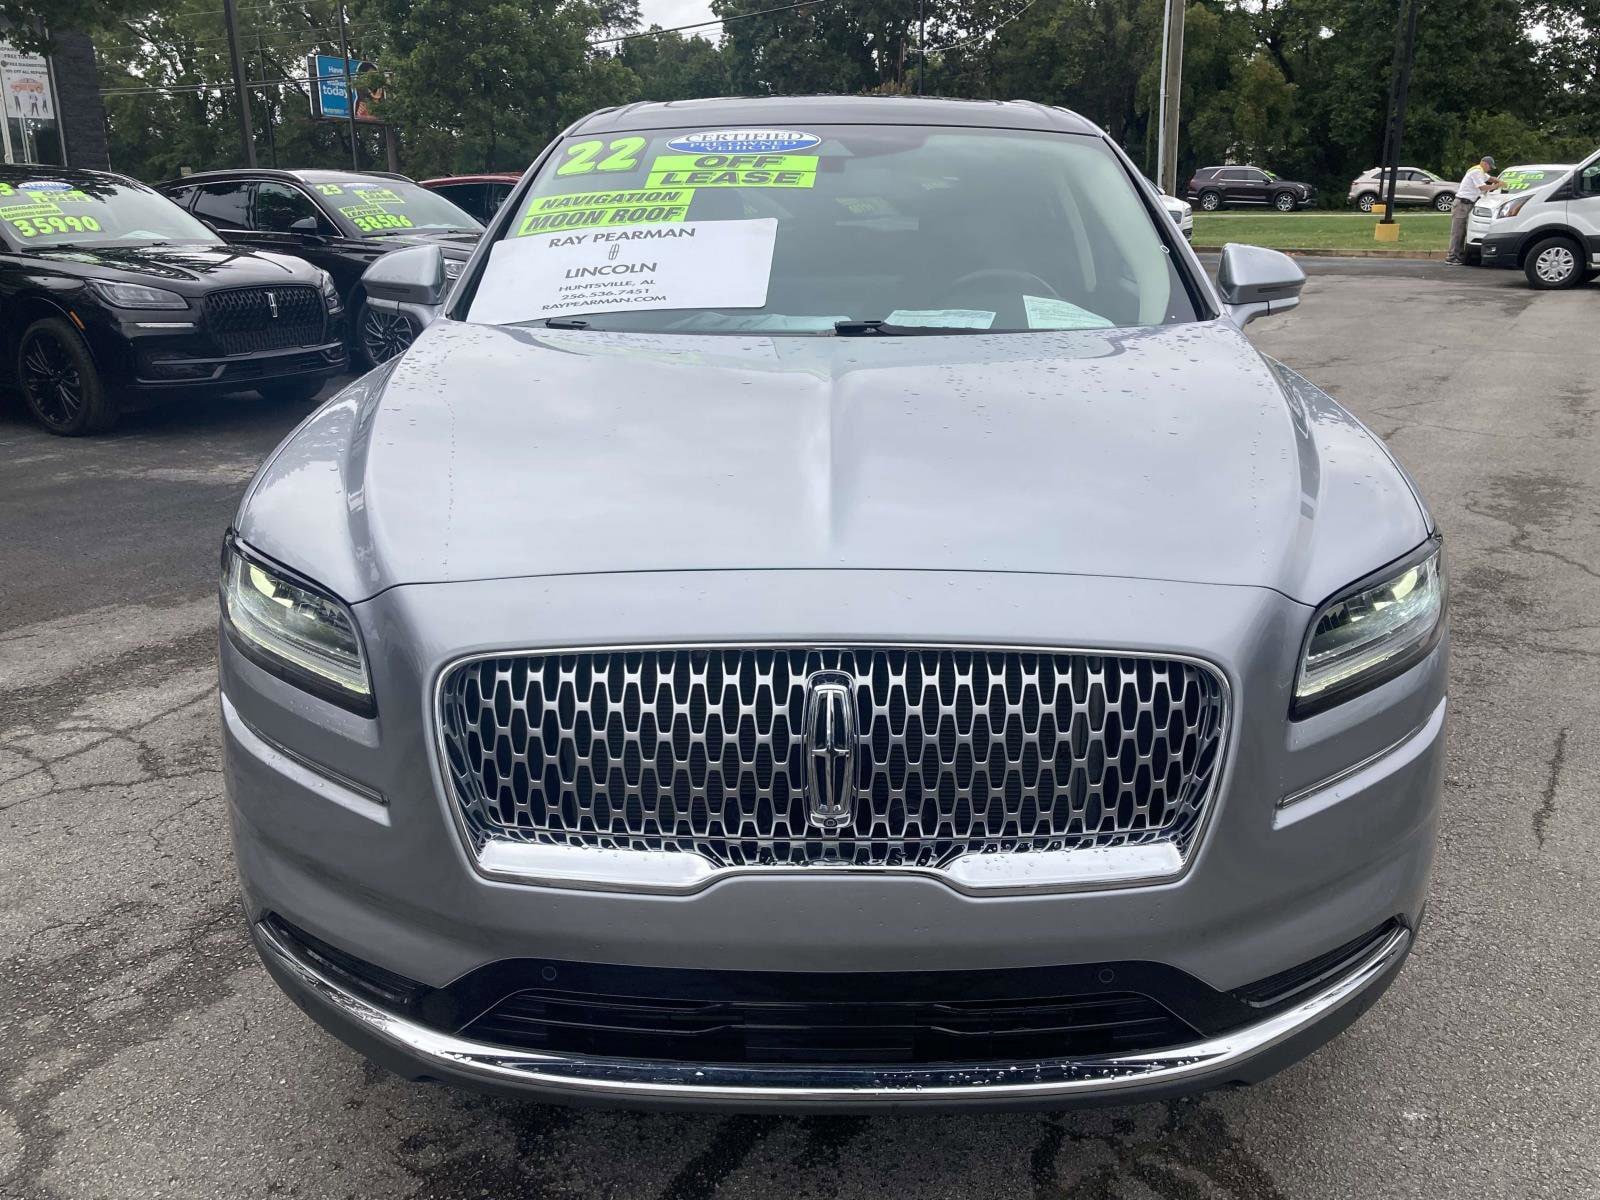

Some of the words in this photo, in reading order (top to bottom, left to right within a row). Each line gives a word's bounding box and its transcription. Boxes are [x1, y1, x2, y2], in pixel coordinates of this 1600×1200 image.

[323, 84, 348, 98] today
[685, 132, 804, 142] CERTIFIED
[557, 137, 646, 176] 22
[694, 155, 786, 169] OFF
[660, 171, 804, 186] LEASE
[539, 191, 683, 210] NAVIGATION
[12, 215, 102, 238] 35990
[353, 214, 413, 232] 38586
[525, 210, 606, 232] MOON
[608, 207, 686, 224] ROOF
[549, 234, 588, 248] RAY
[592, 228, 696, 243] PEARMAN
[565, 262, 658, 279] LINCOLN
[558, 281, 636, 292] HUNTSVILLE,
[561, 288, 650, 300] 256.536.7451
[541, 295, 667, 310] RAYPEARMAN.COM
